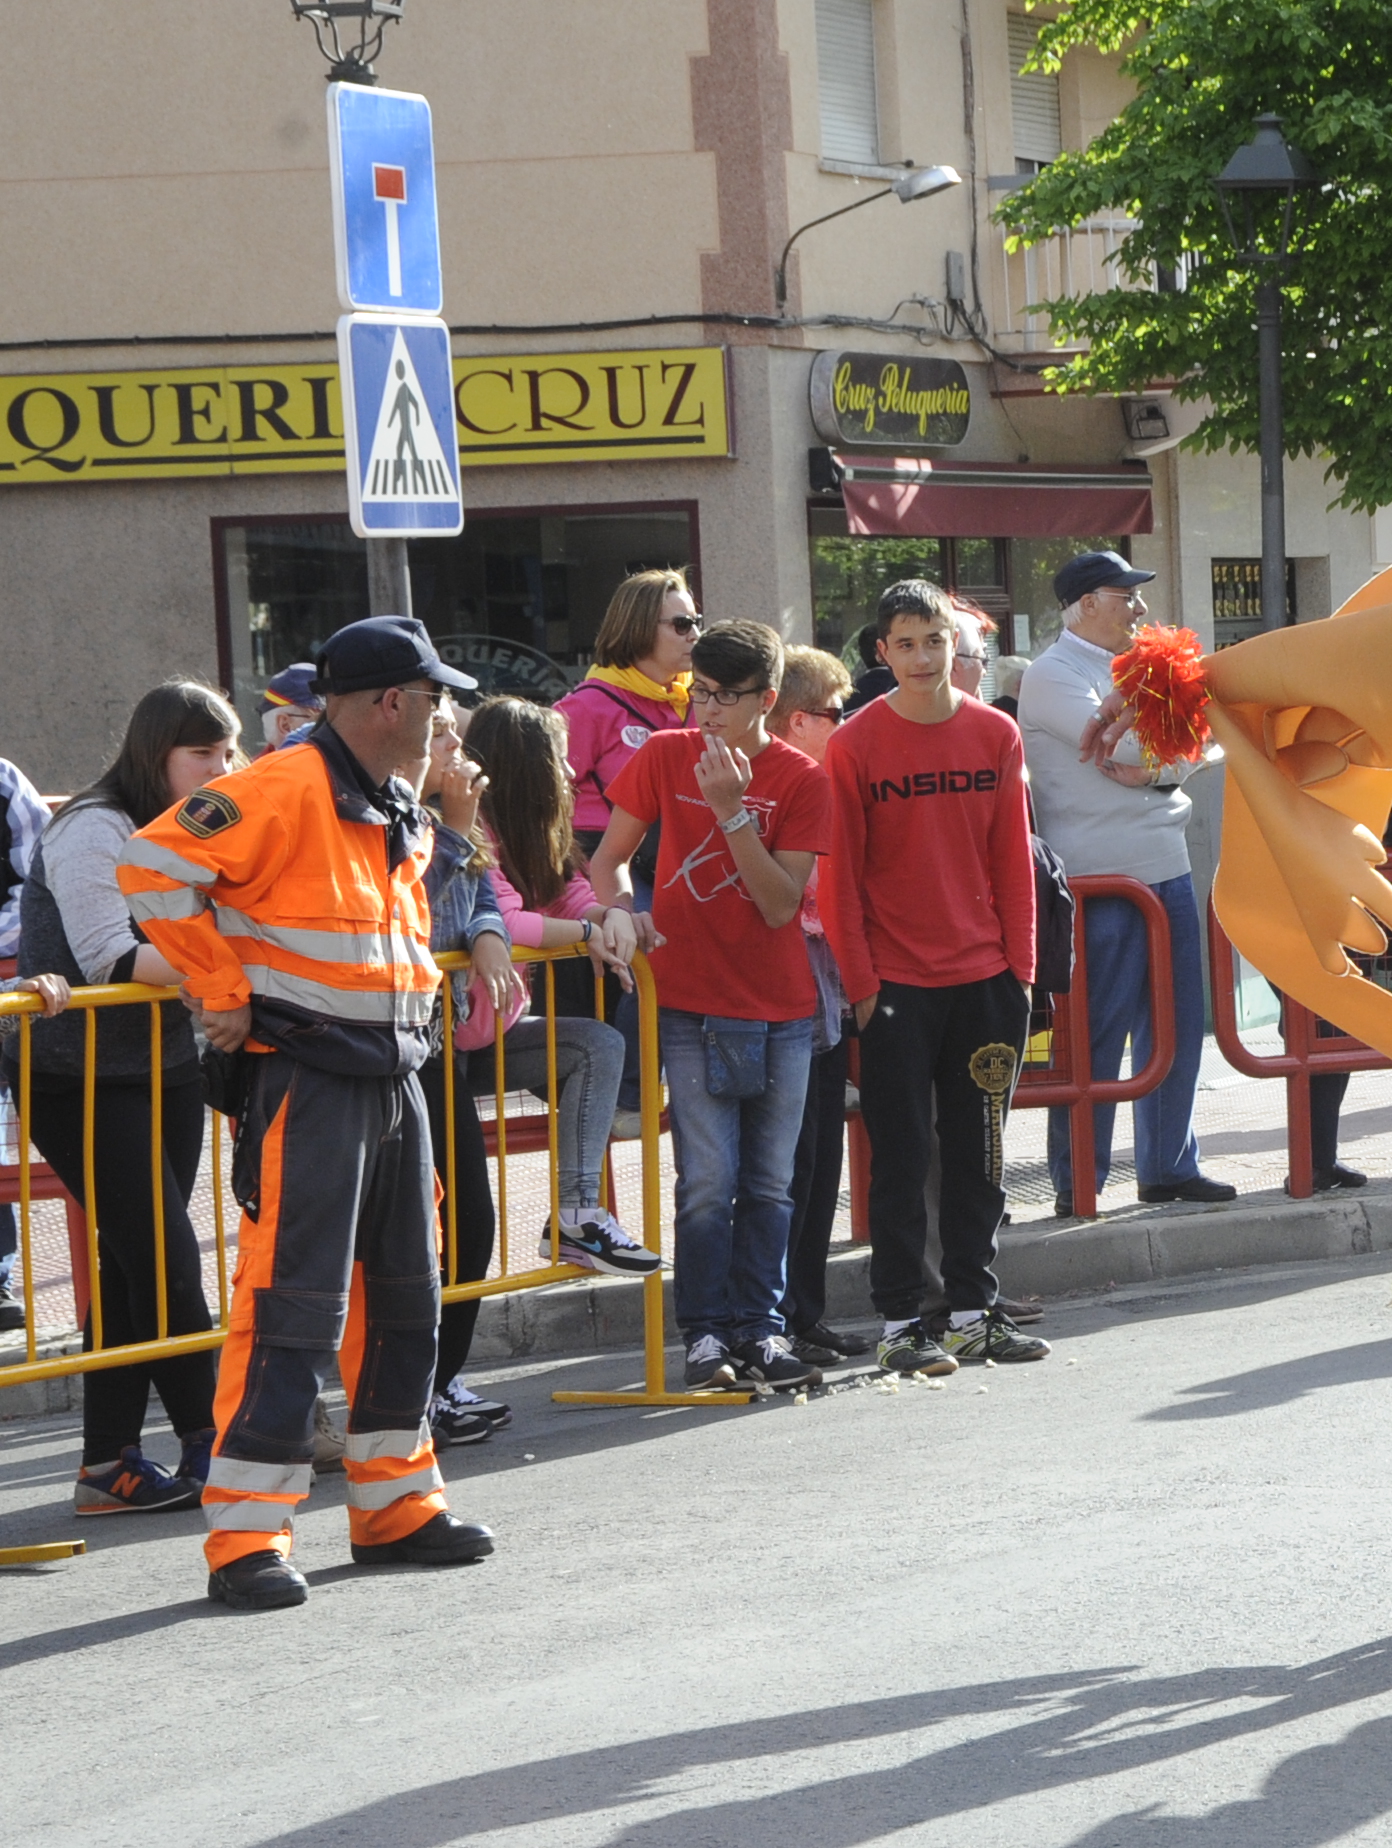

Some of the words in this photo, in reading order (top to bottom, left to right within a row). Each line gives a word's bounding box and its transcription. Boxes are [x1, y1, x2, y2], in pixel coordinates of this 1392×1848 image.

[7, 376, 346, 473] QUERI
[454, 359, 705, 435] CRUZ
[834, 362, 875, 432] Cruz
[879, 363, 968, 436] Peluqueria
